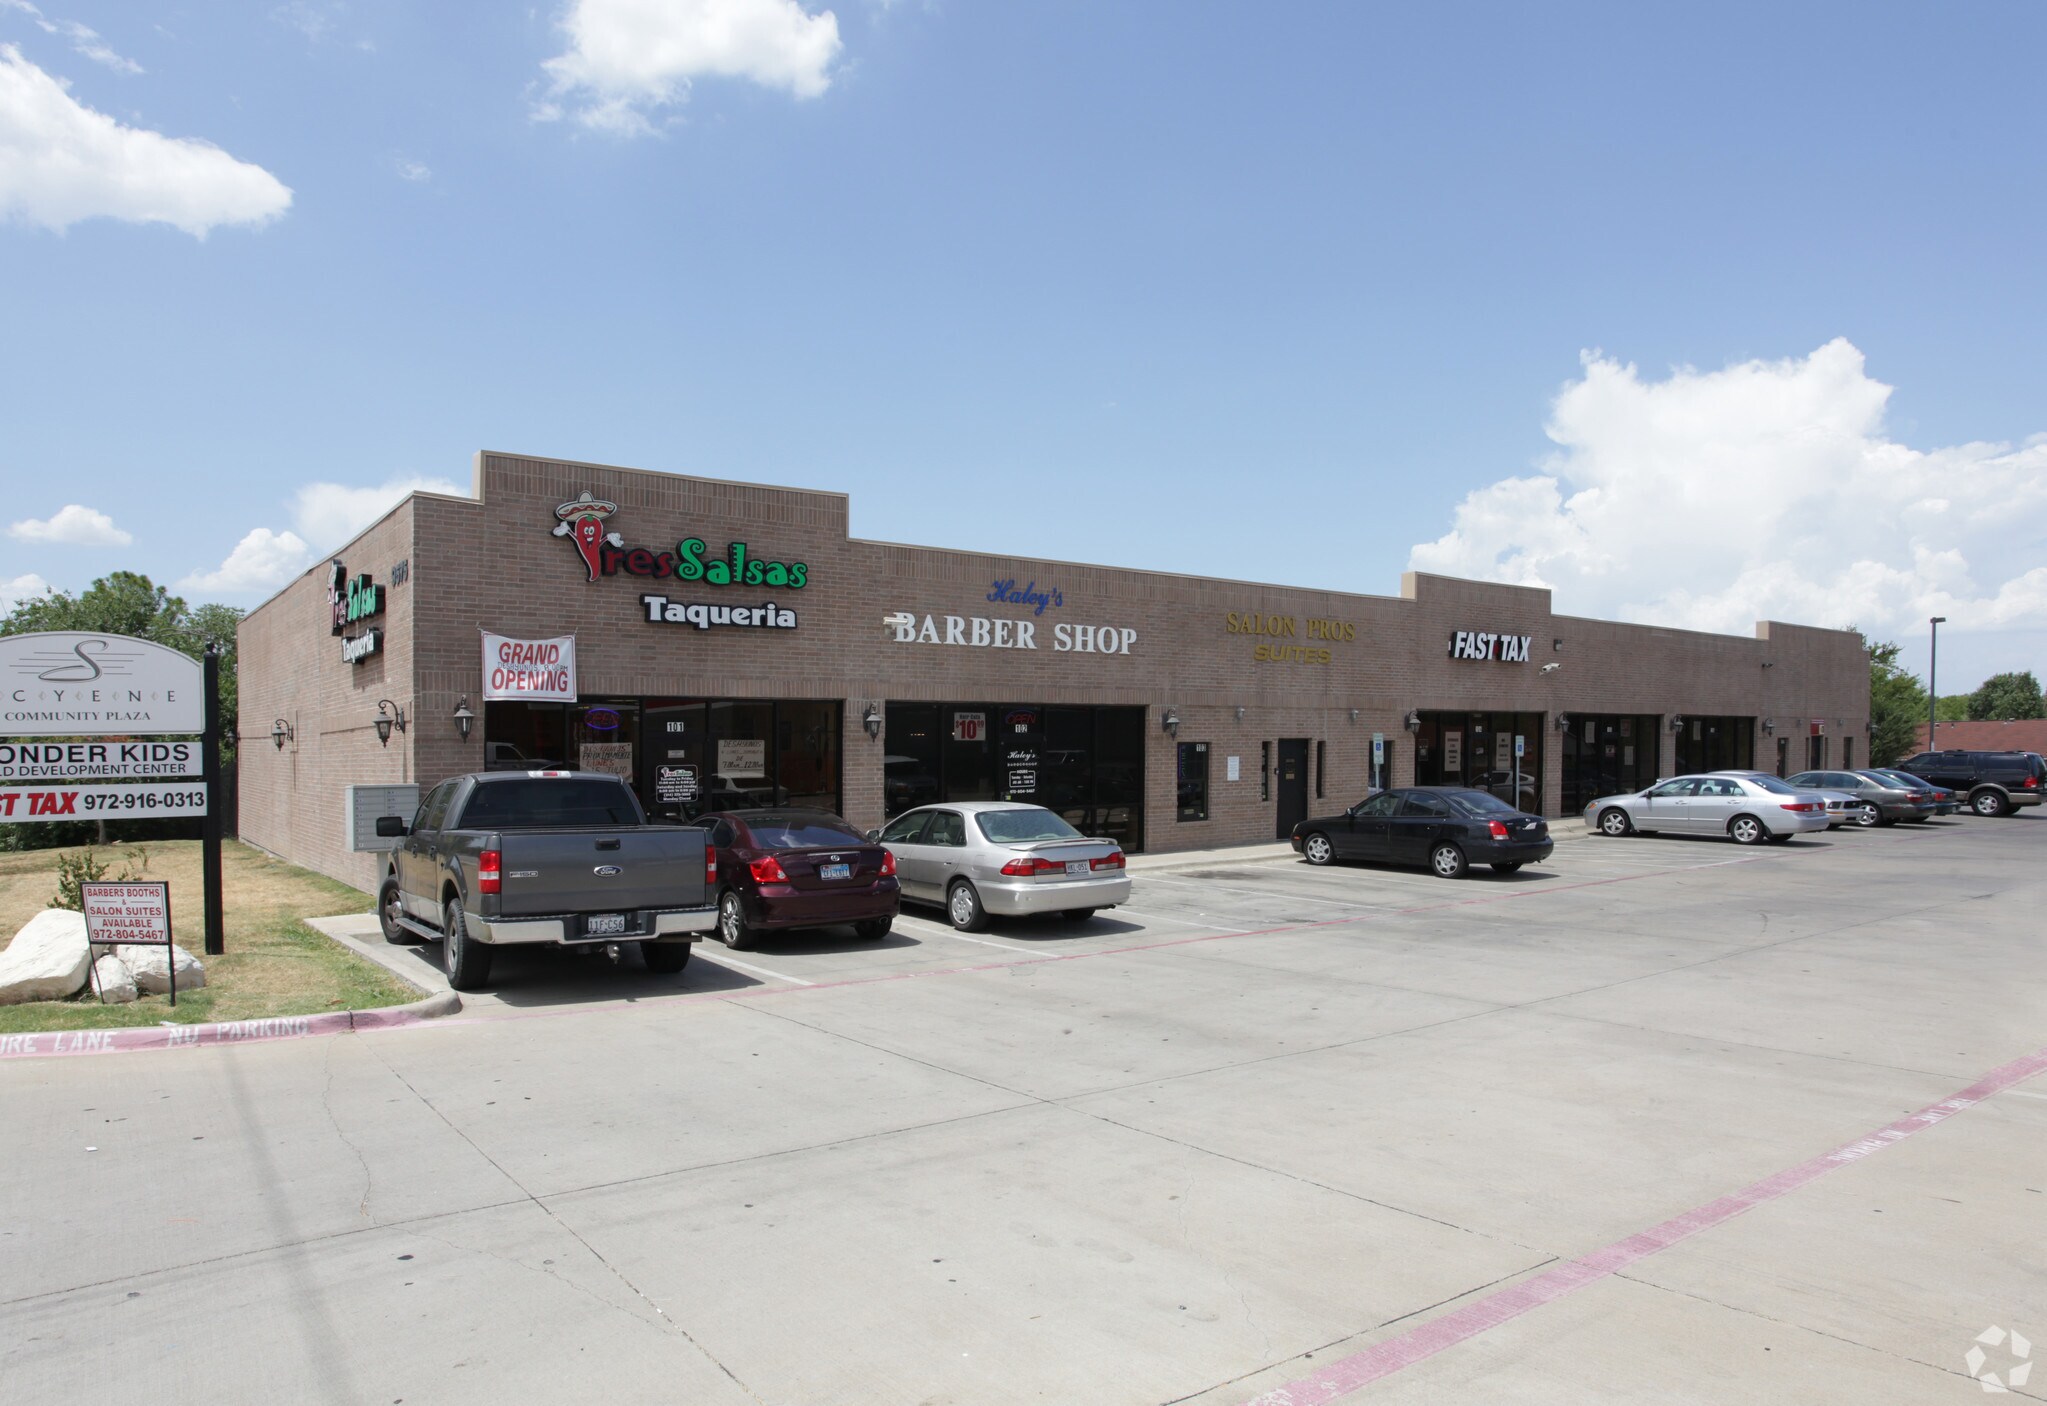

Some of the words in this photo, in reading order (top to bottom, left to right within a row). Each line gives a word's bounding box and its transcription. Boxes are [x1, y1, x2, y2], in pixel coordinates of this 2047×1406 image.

[986, 579, 1063, 616] Haley's
[643, 595, 798, 629] Taqueria
[893, 612, 1037, 649] BARBER
[1053, 623, 1138, 655] SHOP
[1226, 611, 1297, 637] SALON
[1307, 618, 1356, 641] PROS
[498, 642, 560, 665] GRAND
[1254, 644, 1332, 664] SUITES
[1454, 631, 1498, 660] FAST
[1500, 634, 1532, 662] TAX
[491, 668, 568, 692] OPENING
[4, 711, 100, 721] COMMUNITY
[106, 711, 151, 721] PLAZA
[668, 722, 684, 732] 101
[121, 743, 190, 762] KIDS
[0, 766, 14, 776] D
[19, 764, 130, 776] DEVELOPMENT
[133, 763, 186, 774] CENTER
[0, 793, 21, 816] T
[27, 792, 79, 815] TAX
[84, 792, 205, 810] 972-916-0313
[87, 888, 125, 897] BARBERS
[126, 888, 160, 897] BOOTHS
[89, 906, 122, 916] SALON
[125, 907, 162, 916] SUITES
[102, 918, 153, 928] AVAILABLE
[92, 929, 164, 939] 972-804-5467
[54, 1031, 117, 1052] LANE
[216, 1018, 309, 1041] PARKING
